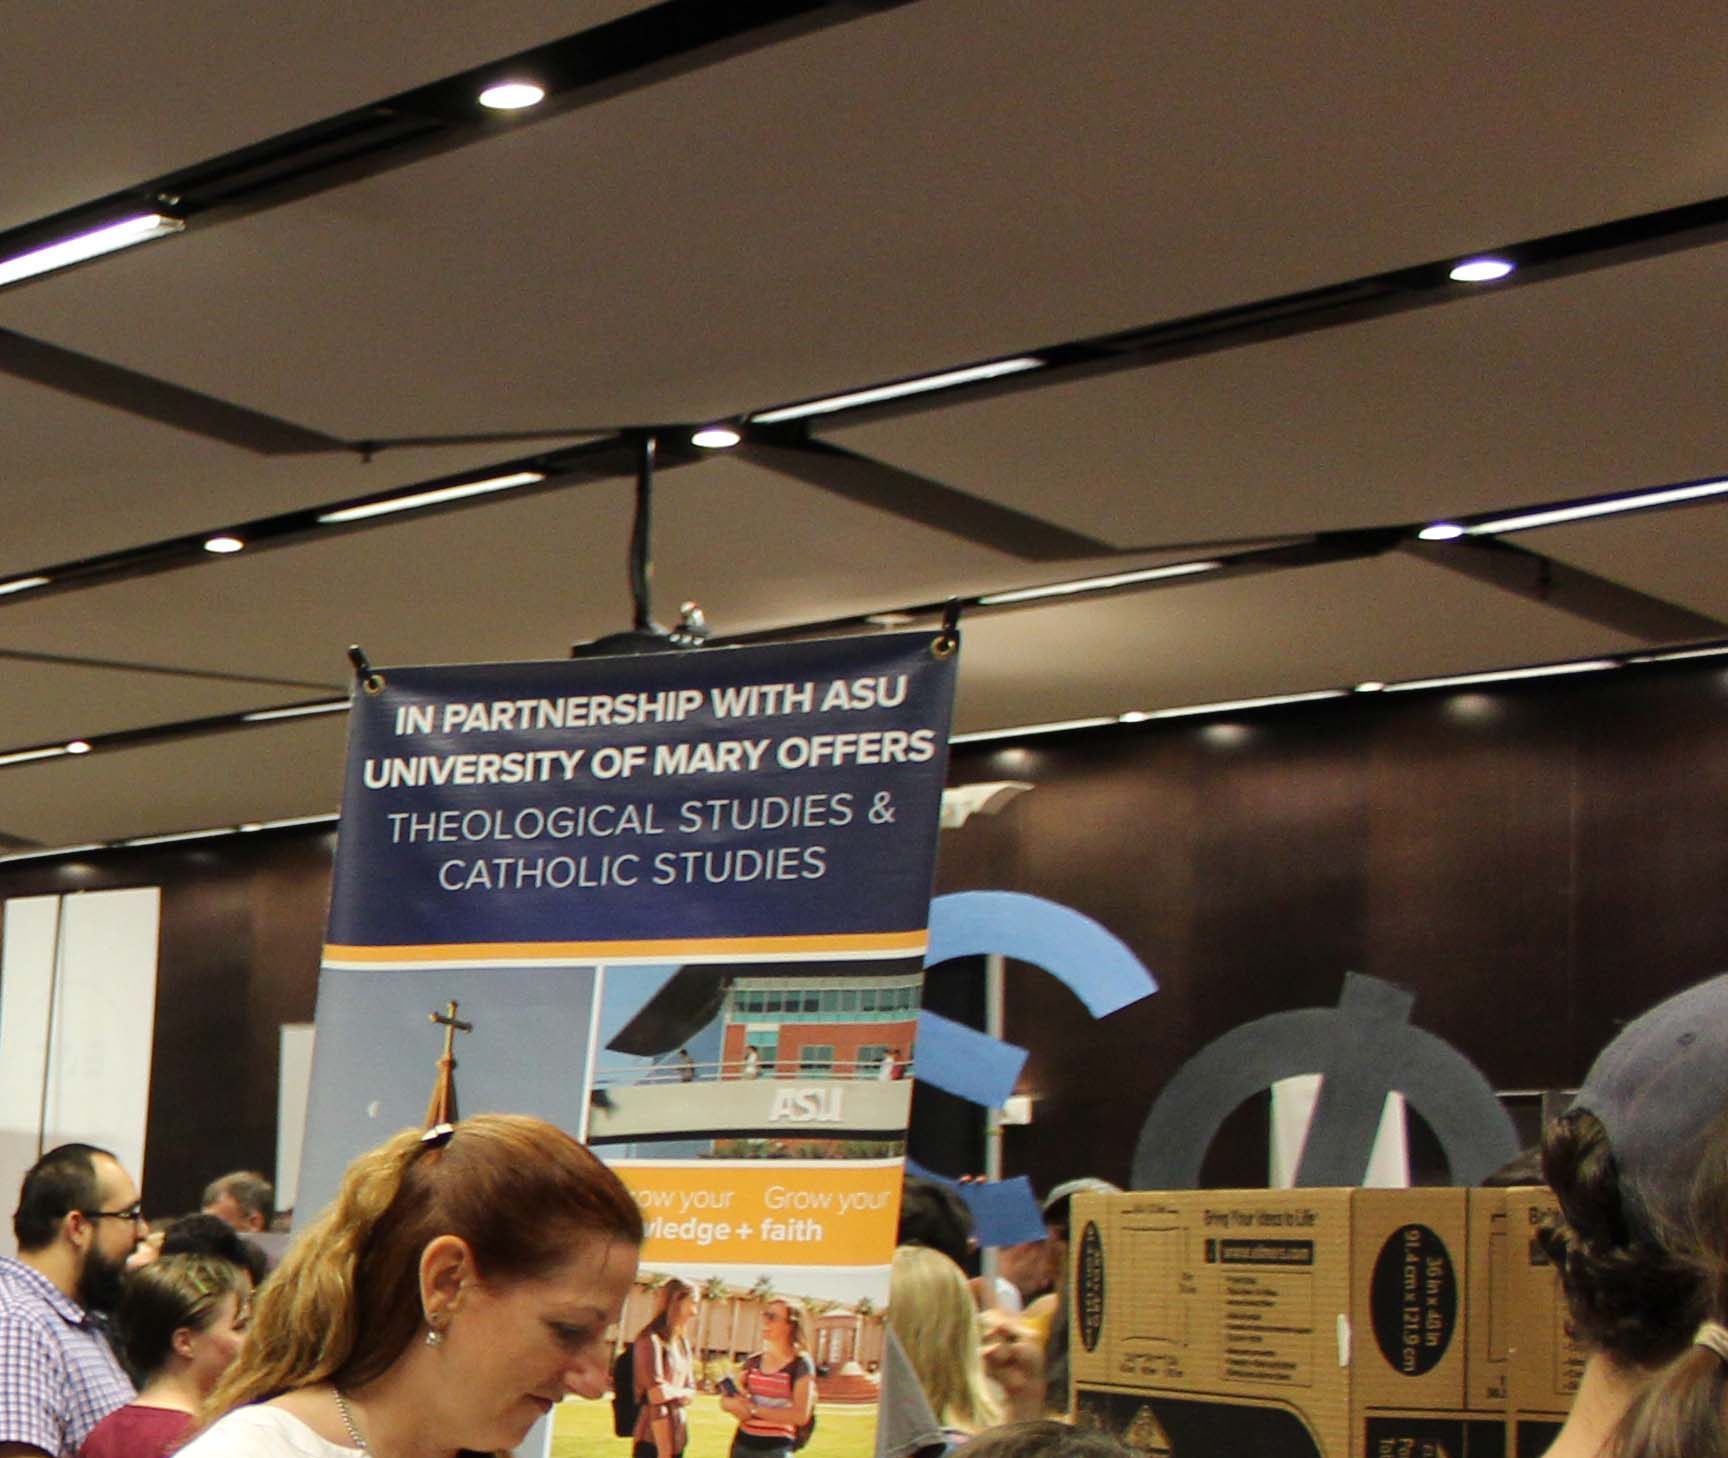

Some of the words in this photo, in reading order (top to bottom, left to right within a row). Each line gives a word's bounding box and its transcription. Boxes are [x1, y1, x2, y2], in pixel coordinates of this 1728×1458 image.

[395, 704, 435, 736] IN
[442, 690, 702, 734] PARTNERSHIP
[711, 682, 815, 720] WITH
[820, 674, 910, 713] ASU
[363, 749, 585, 790] UNIVERSITY
[591, 745, 647, 780] OF
[653, 737, 772, 777] MARY
[776, 729, 936, 769] OFFERS
[388, 803, 665, 844] THEOLOGICAL
[679, 793, 854, 834] STUDIES
[867, 790, 897, 825] &
[438, 853, 641, 891] CATHOLIC
[652, 846, 827, 885] STUDIES
[768, 1087, 844, 1122] ASU
[679, 1190, 735, 1213] your
[764, 1185, 832, 1210] Grow
[836, 1190, 892, 1215] your
[736, 1224, 753, 1240] +
[760, 1218, 823, 1242] faith
